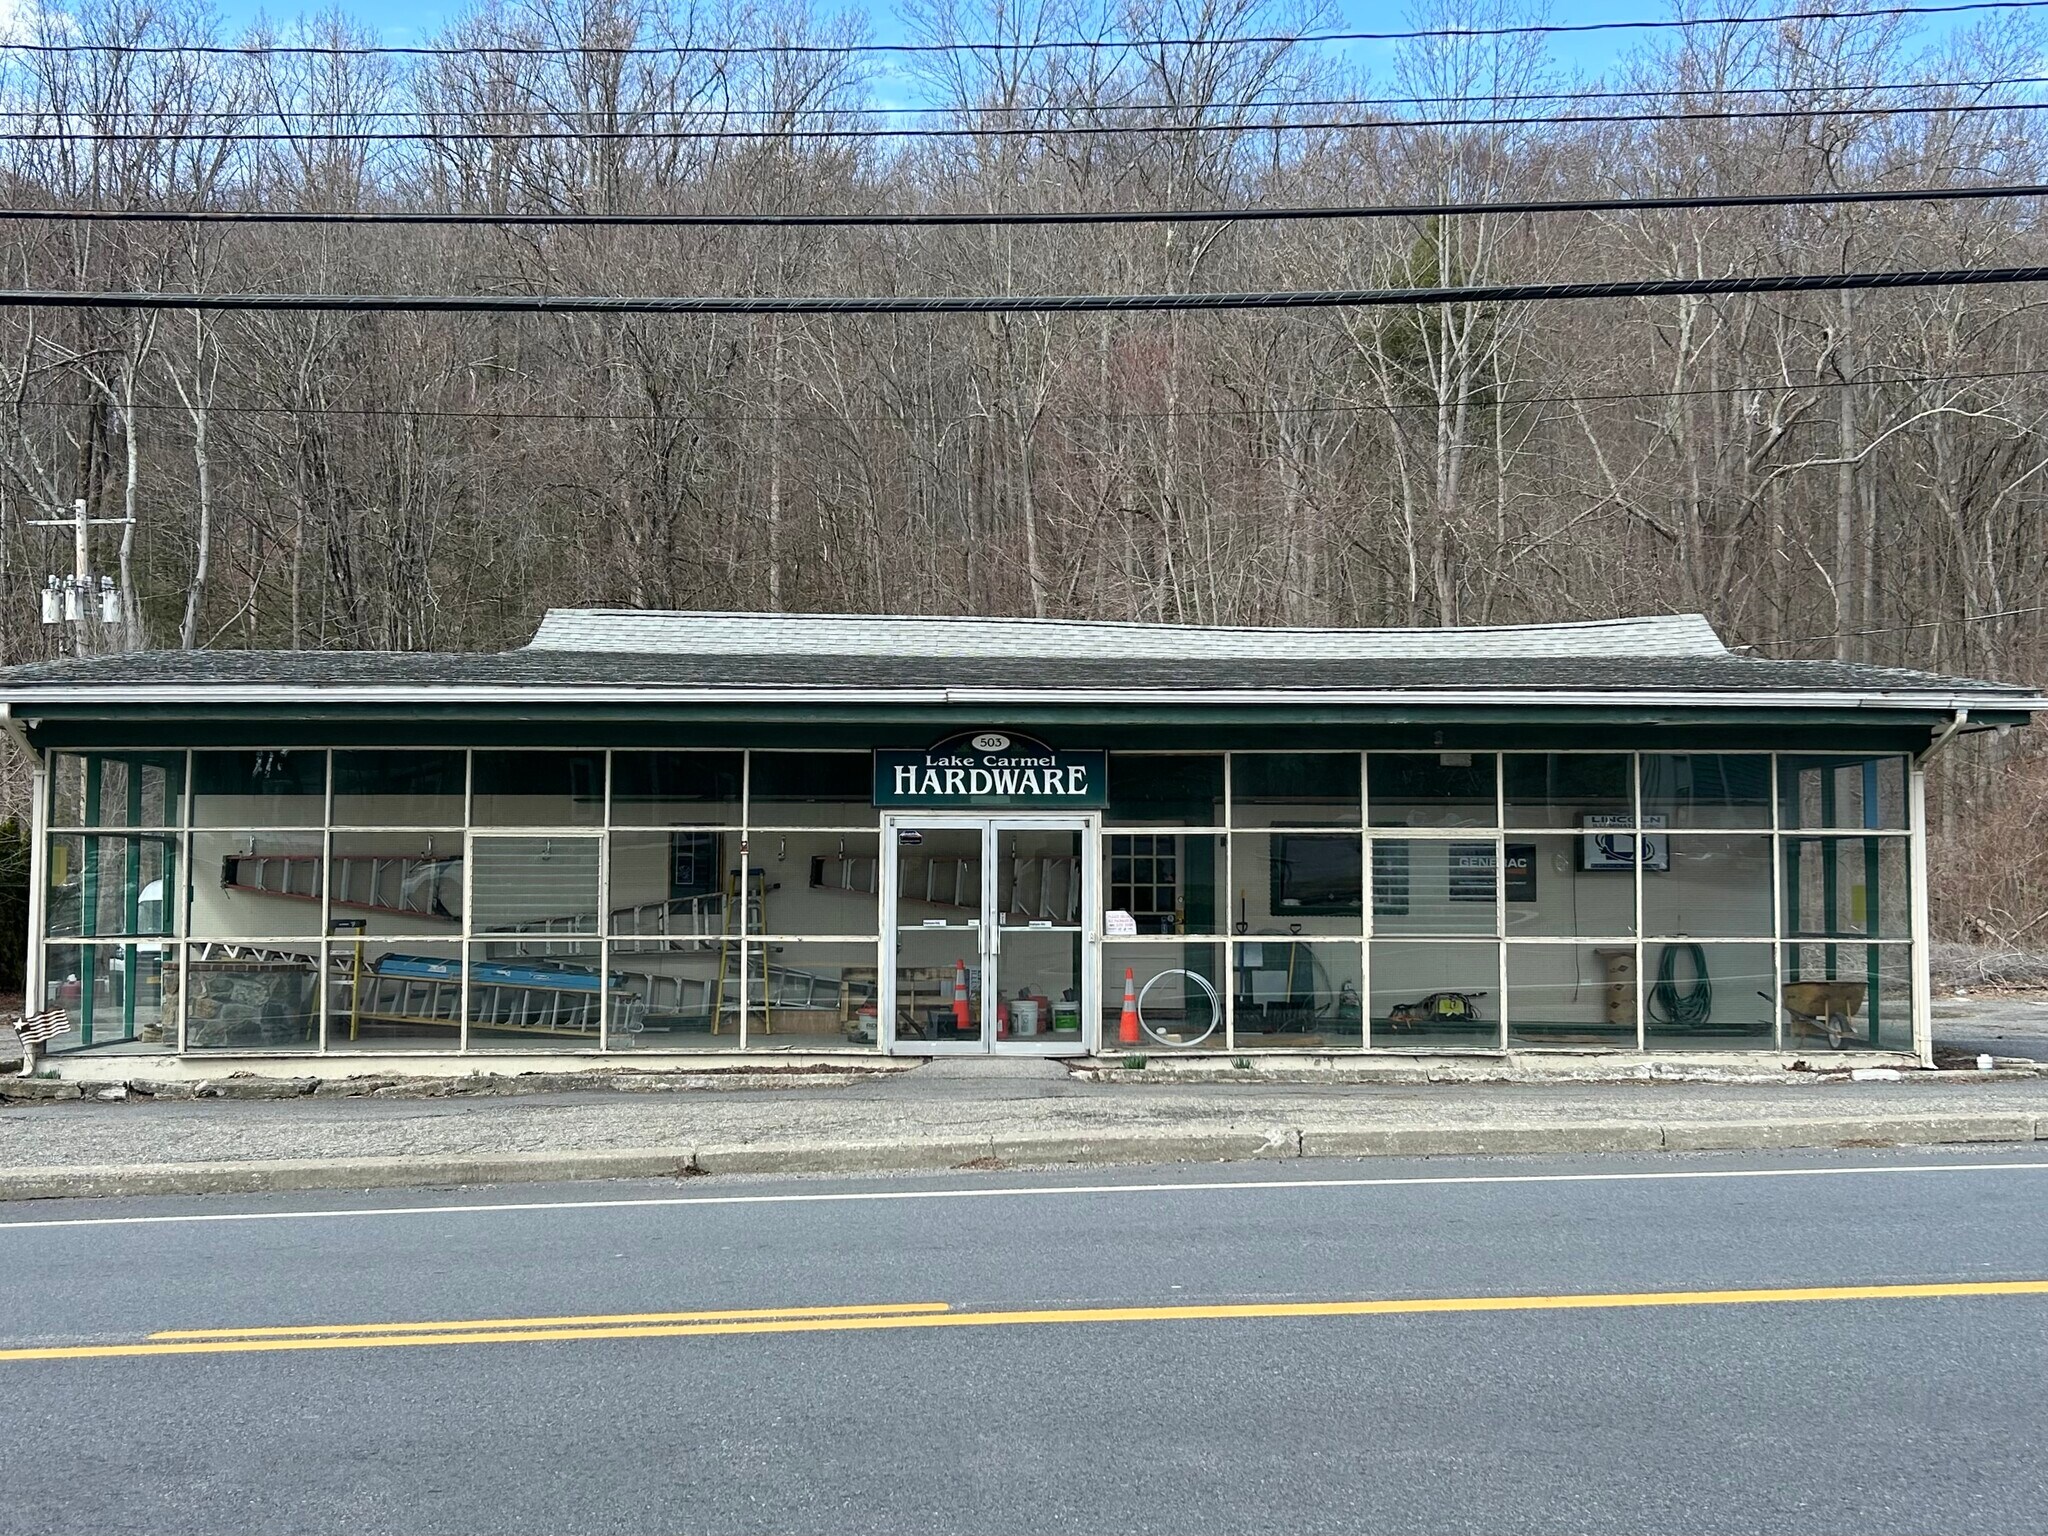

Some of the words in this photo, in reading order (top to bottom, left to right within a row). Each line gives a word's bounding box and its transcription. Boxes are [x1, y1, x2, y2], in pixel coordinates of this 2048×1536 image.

[980, 738, 1002, 747] 503
[925, 755, 975, 766] Lake
[983, 755, 1056, 767] Carmel
[893, 765, 1089, 795] HARDWARE
